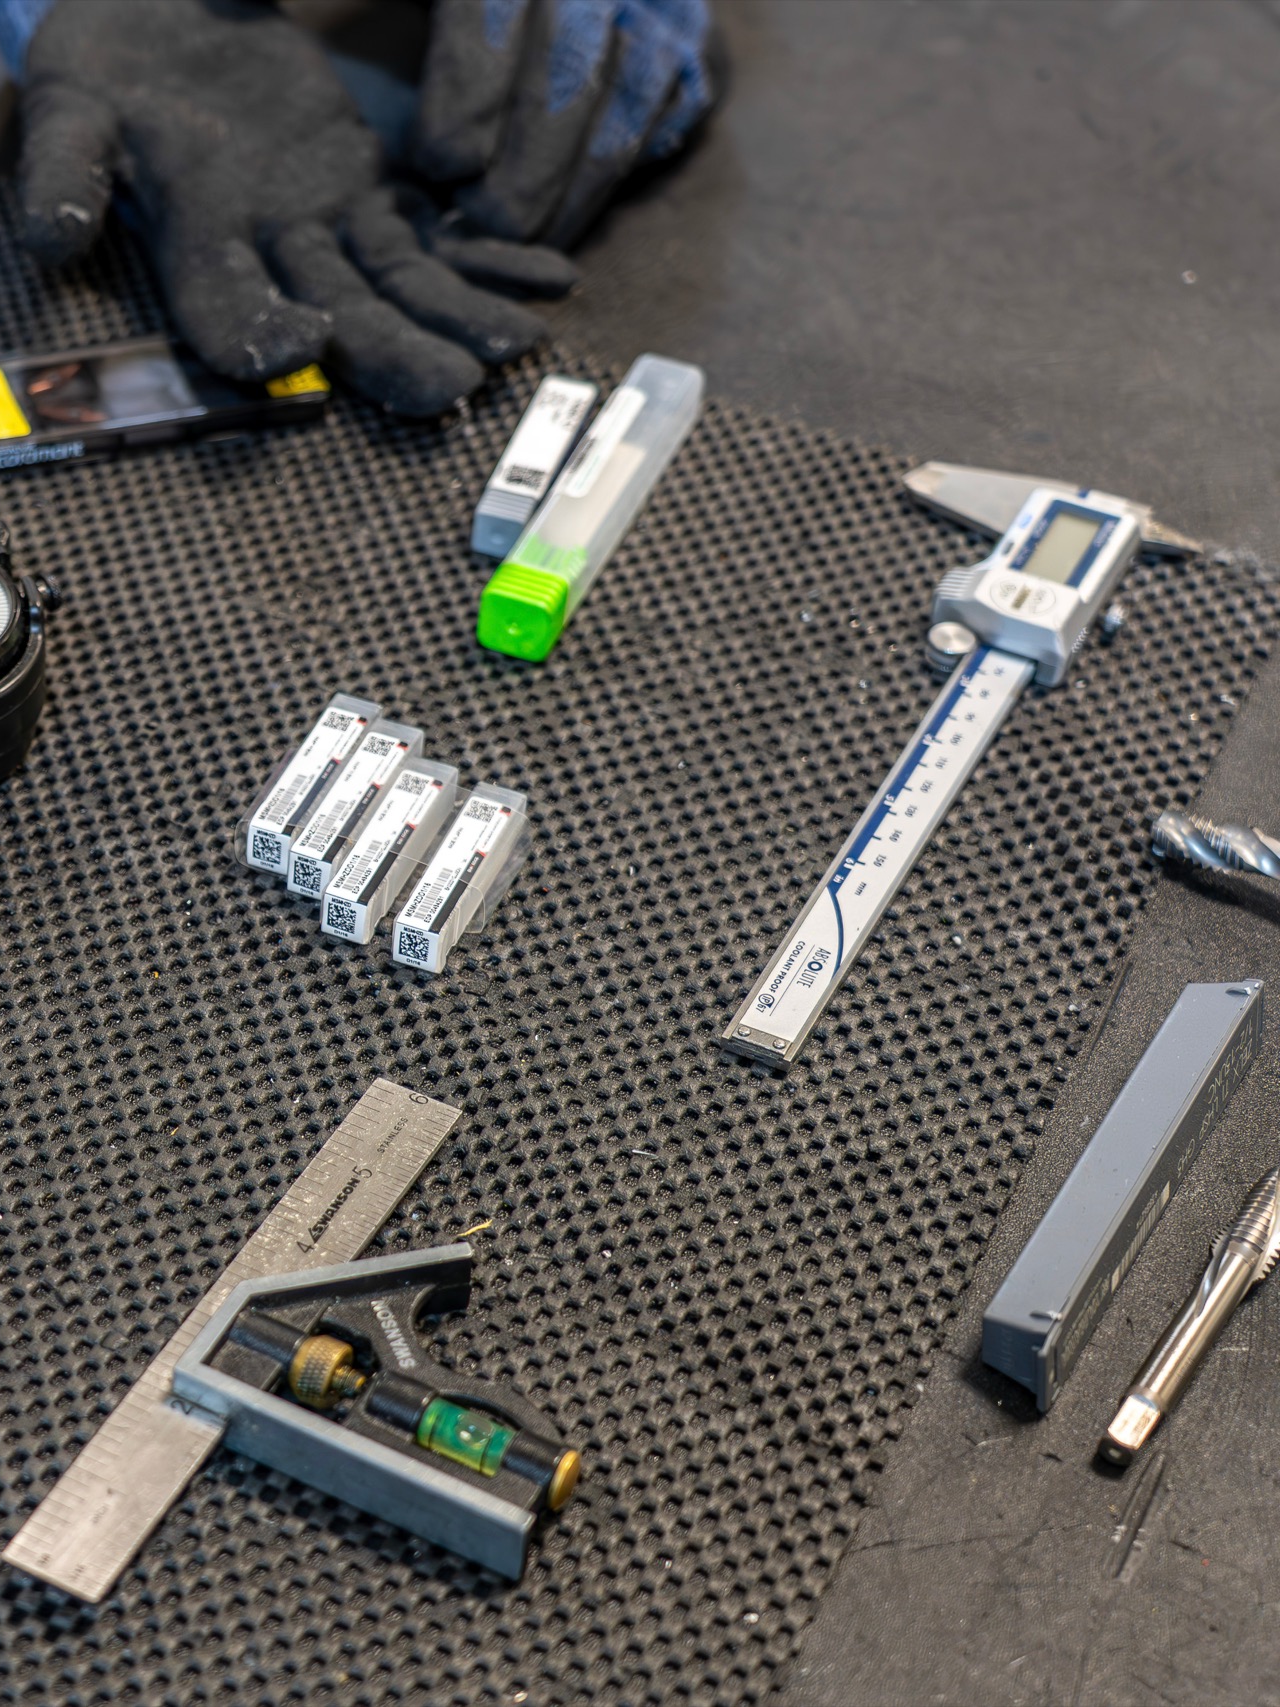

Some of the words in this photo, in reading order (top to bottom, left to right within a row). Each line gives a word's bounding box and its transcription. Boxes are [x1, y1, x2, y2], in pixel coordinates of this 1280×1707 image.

[873, 854, 887, 868] 150
[854, 882, 867, 896] mm
[784, 941, 806, 971] COOLANT
[796, 947, 832, 988] ABSOLUTE
[770, 970, 785, 993] PROOF
[408, 1092, 429, 1105] 6
[377, 1117, 409, 1154] STAINLESS
[352, 1165, 373, 1179] 5
[312, 1177, 361, 1234] SWANSON
[296, 1240, 315, 1254] 4
[370, 1300, 416, 1369] SWANSON
[170, 1399, 195, 1415] 2
